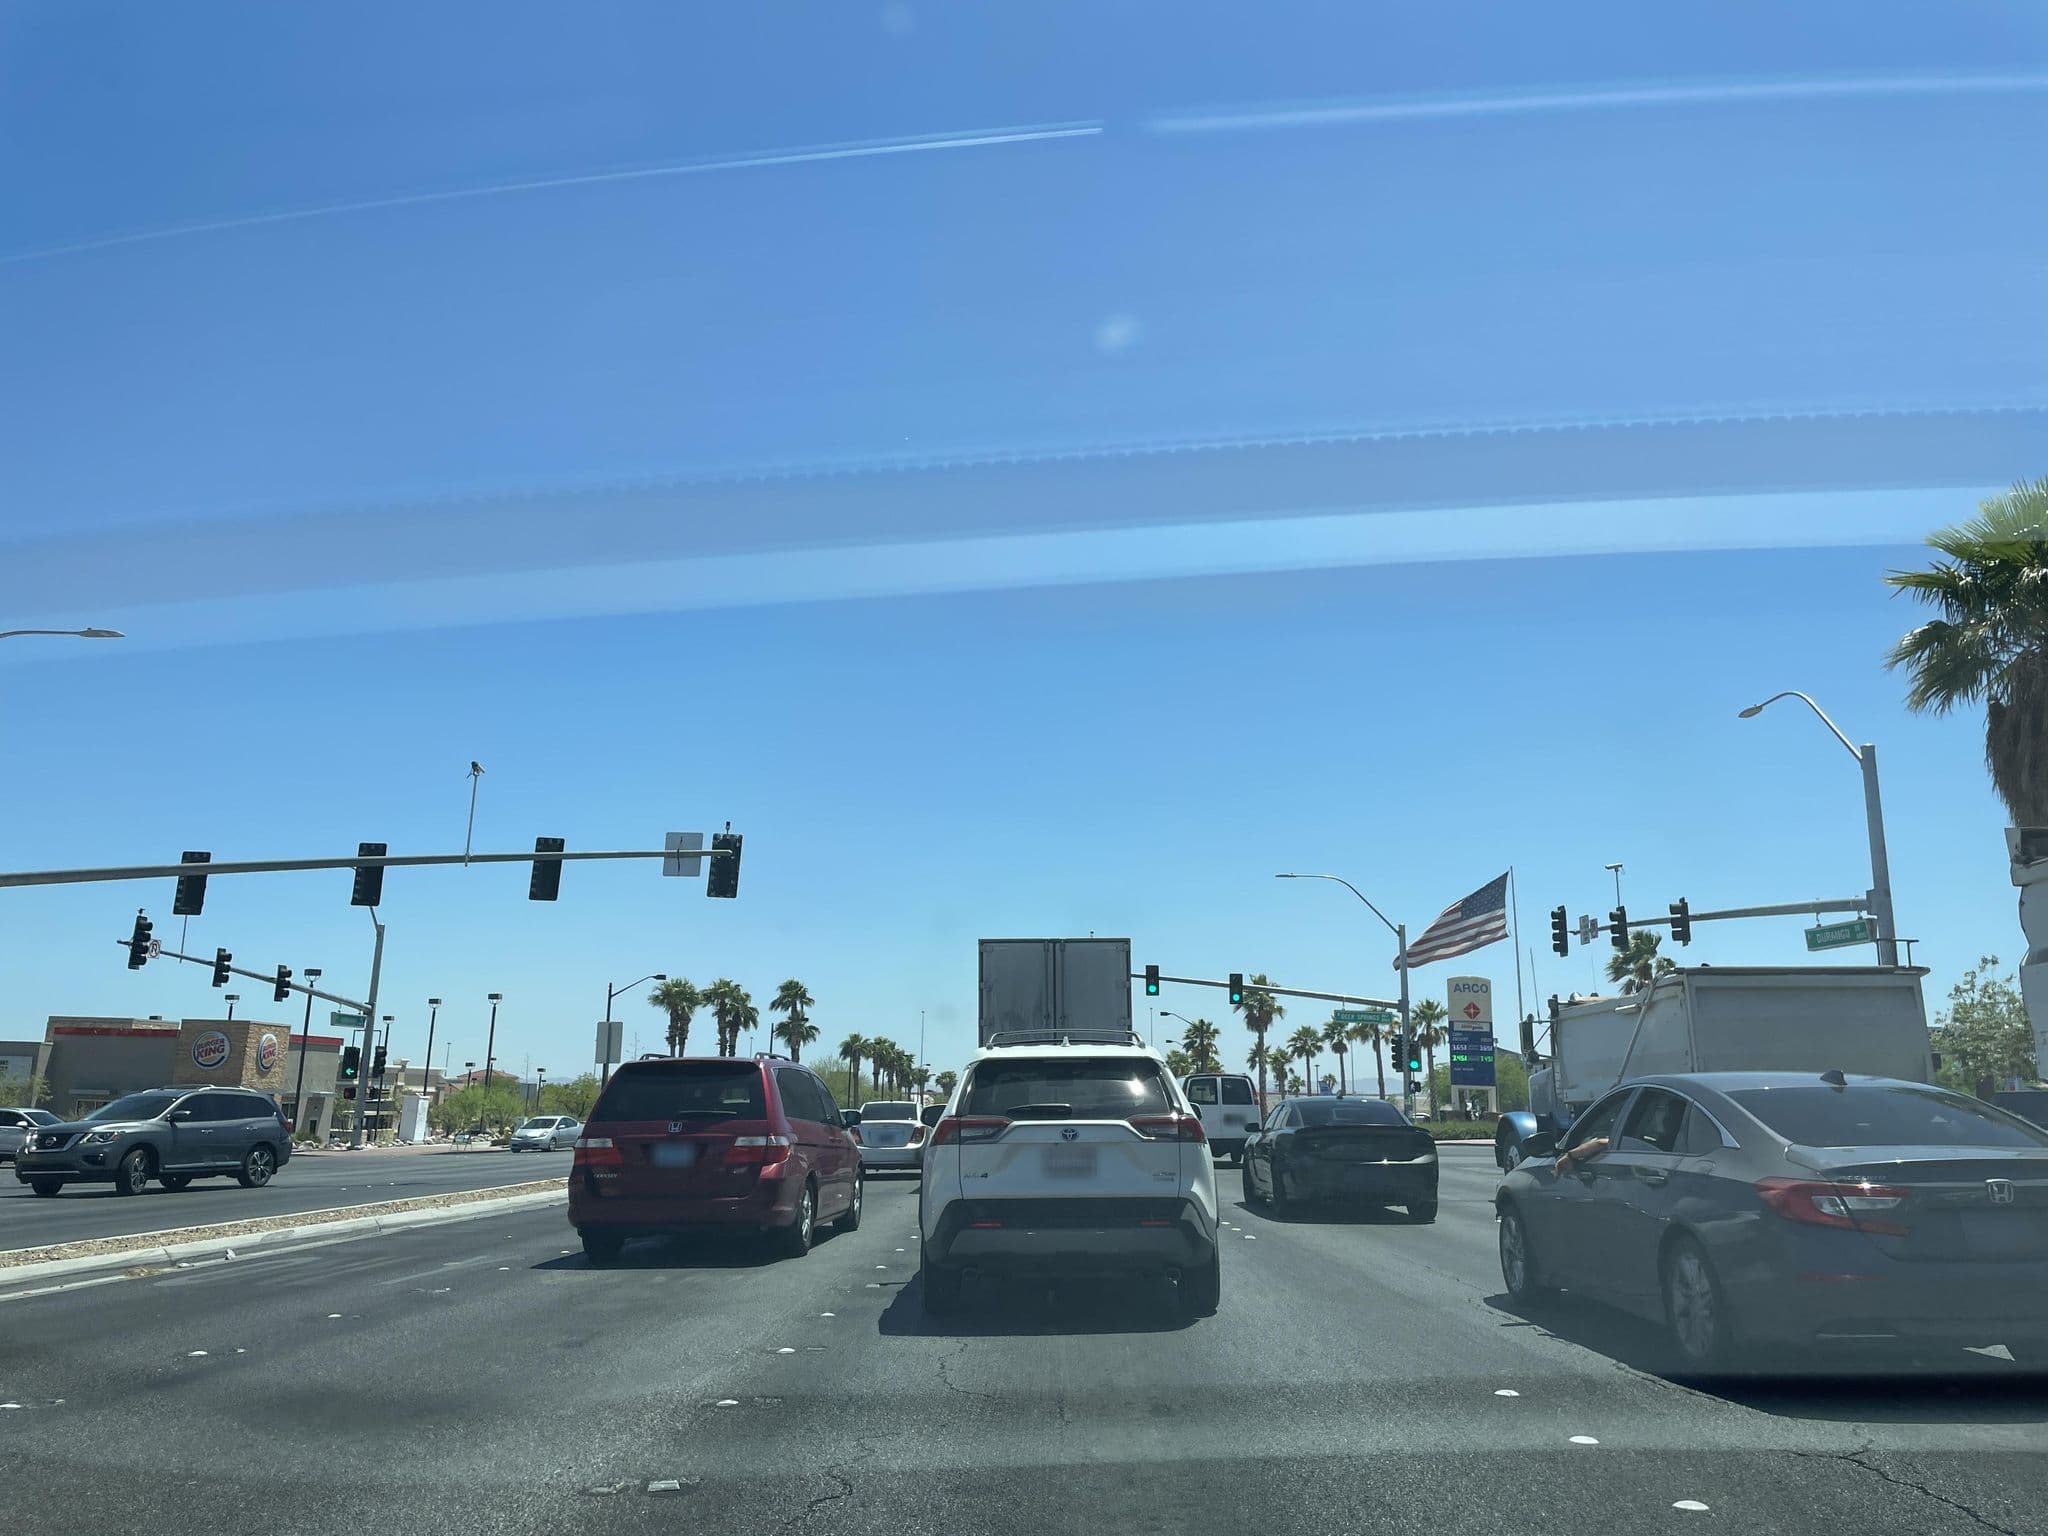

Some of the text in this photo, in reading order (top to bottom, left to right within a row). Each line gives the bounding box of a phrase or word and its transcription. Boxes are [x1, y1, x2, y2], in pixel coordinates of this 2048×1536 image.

[1453, 983, 1489, 994] ARCO
[197, 1038, 225, 1050] BURGER
[196, 1045, 226, 1060] KING
